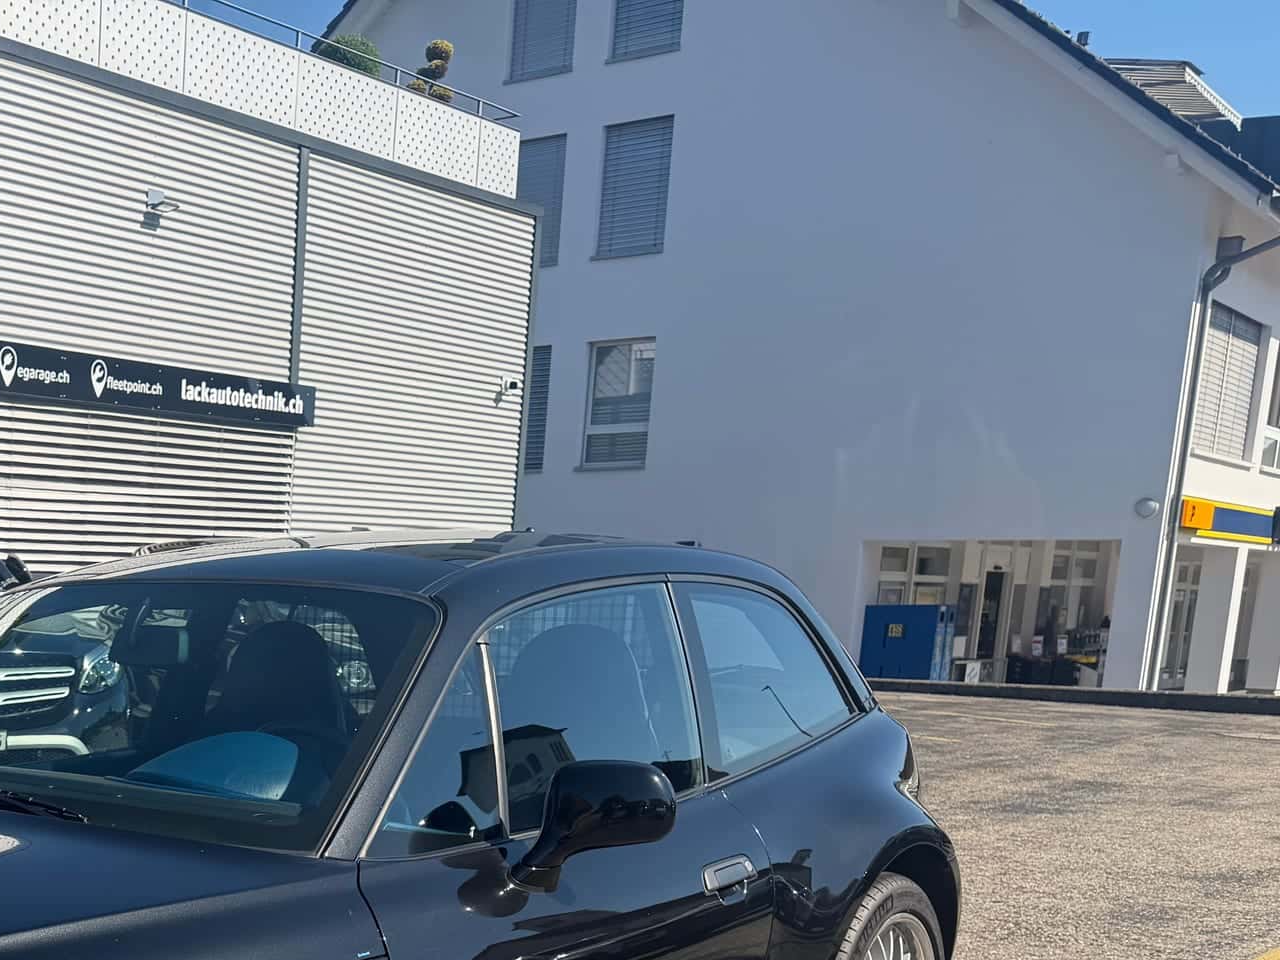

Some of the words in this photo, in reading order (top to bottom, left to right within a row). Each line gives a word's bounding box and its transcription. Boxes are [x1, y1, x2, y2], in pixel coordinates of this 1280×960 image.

[17, 366, 70, 384] egarage.ch
[107, 375, 163, 397] fleetpoint.ch
[181, 378, 304, 415] lackautotechnik.ch
